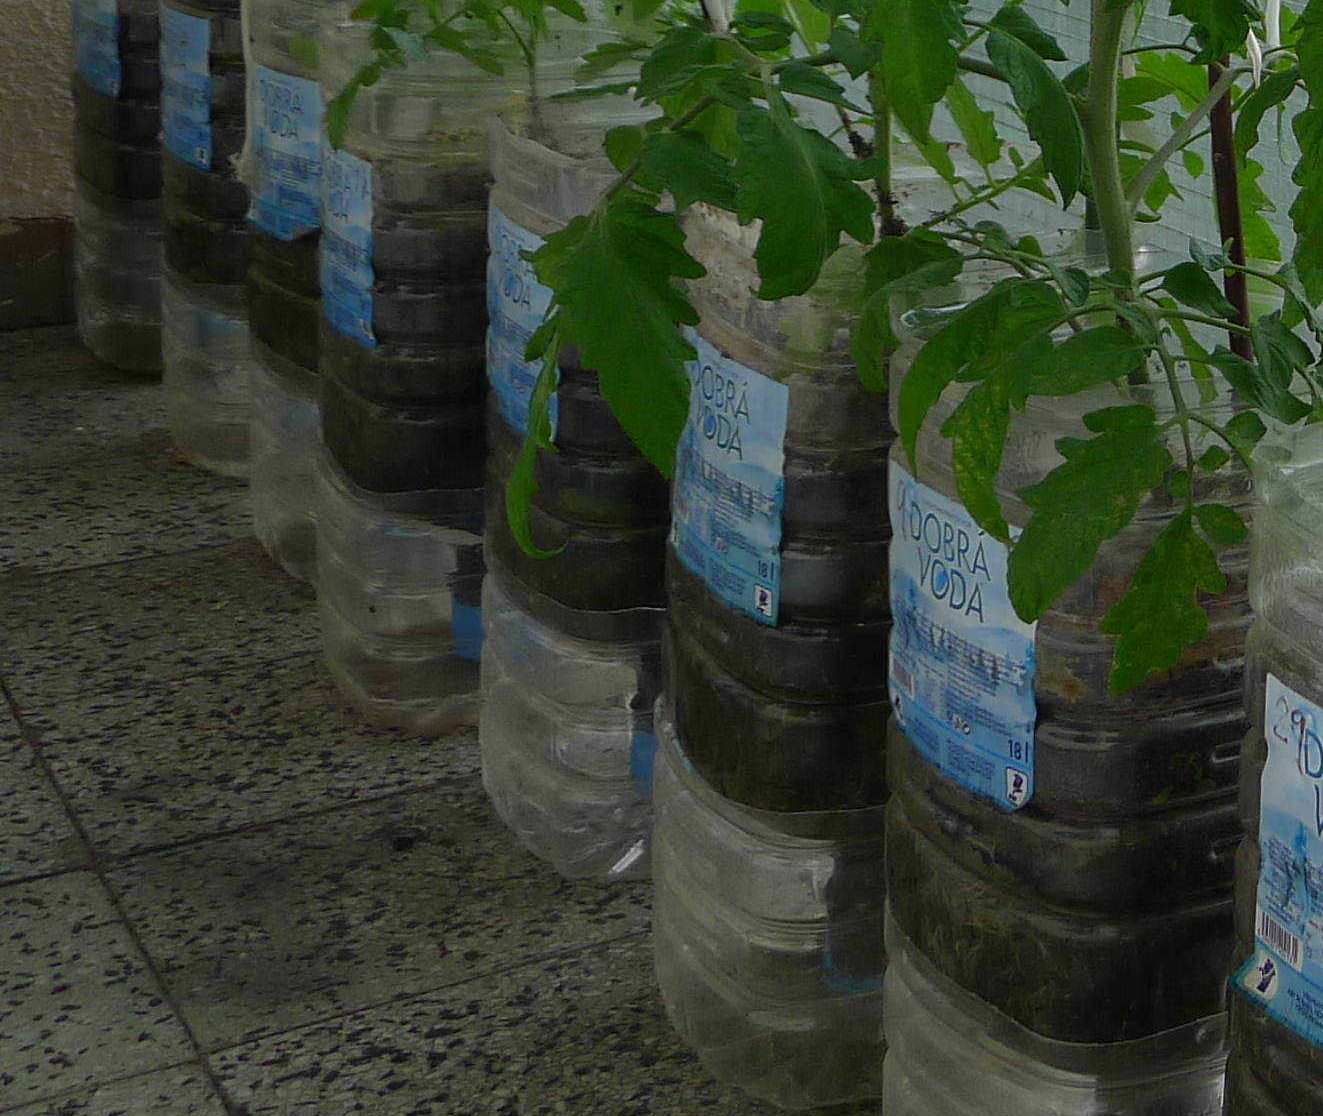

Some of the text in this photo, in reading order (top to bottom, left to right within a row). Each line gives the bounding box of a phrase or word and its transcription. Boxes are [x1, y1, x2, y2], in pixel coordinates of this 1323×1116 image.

[910, 500, 991, 582] DOBRÁ
[917, 546, 984, 624] VODA
[1008, 739, 1022, 760] 18
